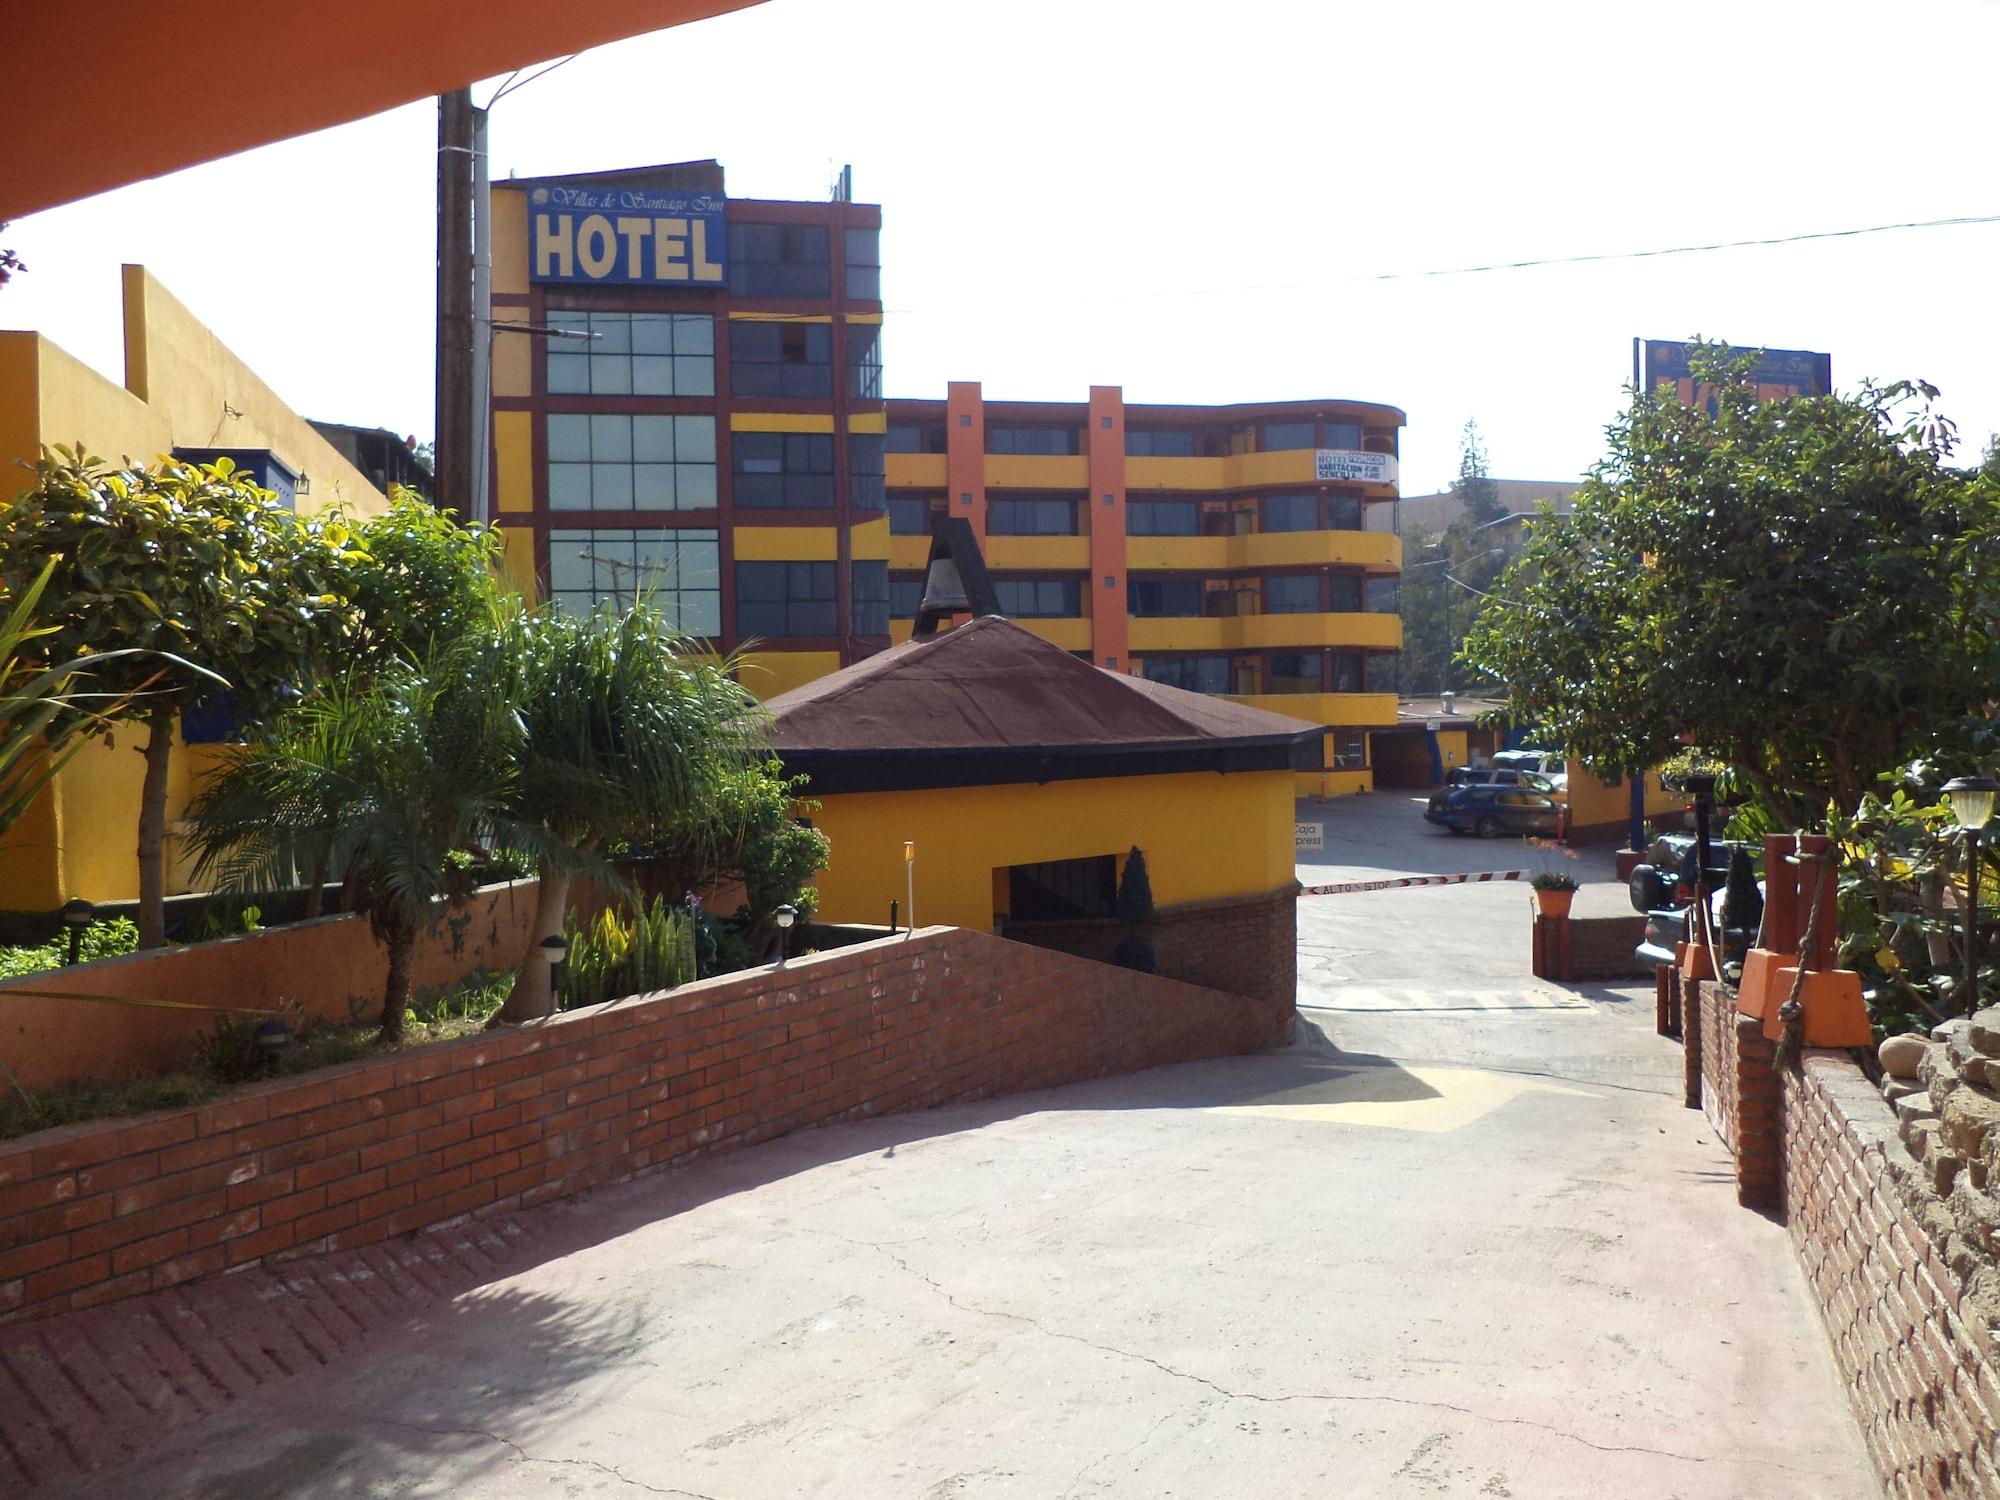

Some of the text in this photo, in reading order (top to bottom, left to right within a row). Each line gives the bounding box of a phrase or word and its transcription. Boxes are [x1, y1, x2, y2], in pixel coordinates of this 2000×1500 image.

[552, 188, 725, 215] Villas de Santiago Inn
[536, 214, 723, 281] HOTEL
[1322, 880, 1391, 895] ALTO STOP
